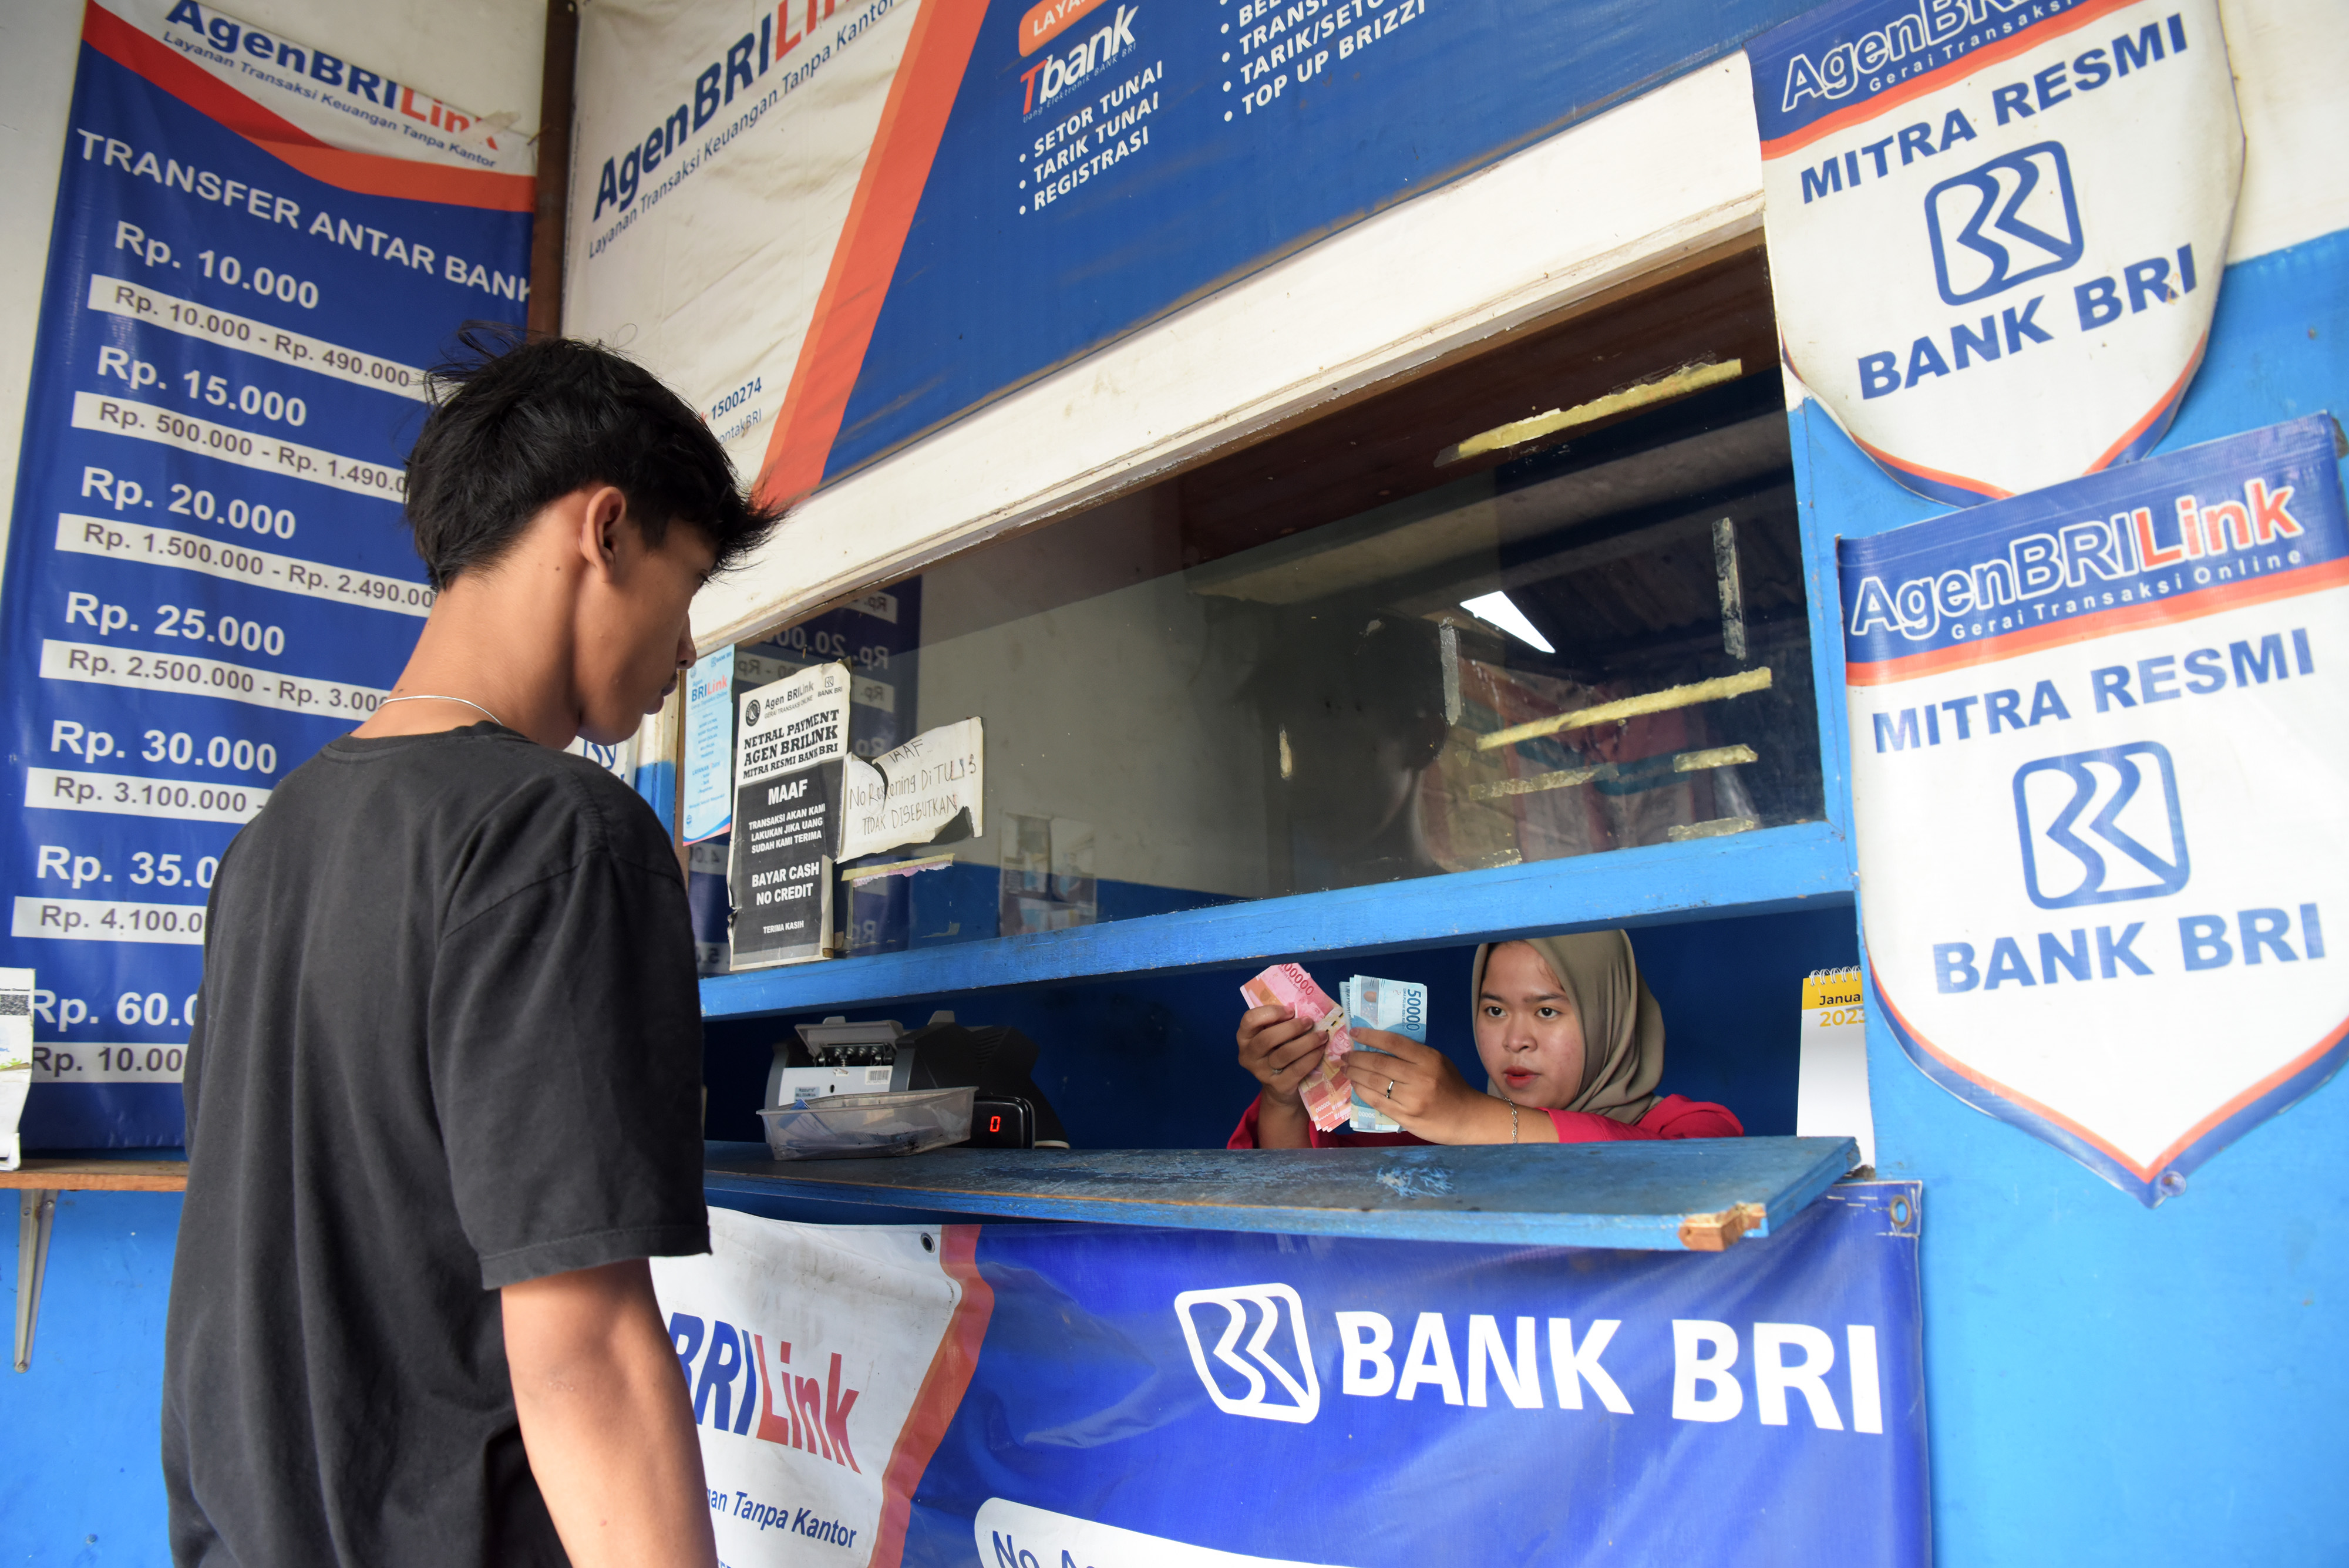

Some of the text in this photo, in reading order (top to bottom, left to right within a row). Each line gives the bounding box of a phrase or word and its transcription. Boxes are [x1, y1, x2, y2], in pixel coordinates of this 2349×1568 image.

[1020, 4, 1139, 116] Tbank
[1023, 42, 1136, 123] Uang Elektronik BANK BRI
[1242, 0, 1425, 115] TOP UP BRIZZI
[1869, 53, 1933, 93] Gerai
[163, 31, 497, 169] Layanan Transaksi Keuangan Tanpa Kantor
[1034, 60, 1162, 159] SETOR TUNAI
[1801, 13, 2188, 204] MITRA RESMI
[589, 207, 637, 260] Layanan
[640, 148, 700, 214] Transaksi
[704, 89, 778, 162] Keuangan
[782, 45, 830, 95] Tanpa
[1034, 91, 1159, 185] TARIK TUNAI
[1034, 126, 1150, 212] REGISTRASI
[77, 128, 301, 230] TRANSFER
[309, 211, 436, 275] ANTAR
[114, 220, 319, 309] Rp. 10.000
[114, 285, 159, 318] Rp.
[169, 303, 251, 343] 10.000
[274, 333, 315, 362] Rp.
[321, 350, 410, 388] 490.000
[1857, 243, 2198, 401] BANK BRI
[97, 345, 307, 426] Rp. 15.000
[711, 376, 762, 420] 1500274
[99, 401, 145, 429] Rp.
[156, 414, 253, 457] 500.000
[278, 446, 318, 473] Rp.
[81, 466, 296, 540] Rp. 20.000
[83, 523, 131, 550] Rp.
[142, 533, 264, 575] 1.500.000
[288, 564, 328, 591] Rp.
[1850, 477, 2304, 641] AgenBRILink
[65, 591, 285, 656] Rp. 25.000
[1951, 550, 2301, 640] Gerai Transaksi Online
[68, 649, 116, 677] Rp.
[127, 655, 254, 692] 2.500.000
[278, 680, 320, 706] Rp.
[329, 688, 388, 712] 3.00
[692, 674, 728, 702] BRILink
[765, 681, 814, 710] Agen BRILink
[817, 689, 834, 698] BANK
[1872, 627, 2315, 754] MITRA RESMI
[743, 727, 785, 750] NETRAL
[786, 709, 839, 736] PAYMENT
[764, 710, 778, 719] GERAI
[778, 702, 800, 715] TRANSAKSI
[51, 719, 278, 775] Rp. 30.000
[743, 743, 778, 766] AGEN
[780, 725, 838, 755] BRILINK
[743, 764, 769, 779] MITRA
[770, 756, 796, 771] RESMI
[798, 748, 818, 763] BANK
[819, 743, 838, 755] BRI
[54, 776, 248, 812] Rp. 3.100.000
[748, 803, 826, 830] TRANSAKSI AKAN KAMI
[768, 779, 808, 805] MAAF
[849, 785, 866, 810] No
[862, 793, 958, 836] TIDAK DISEBUTKAN
[751, 817, 823, 842] LAKUKAN JIKA UANG
[751, 830, 822, 854] SUDAH KAMI TERIMA
[36, 844, 113, 889] Rp.
[752, 862, 820, 887] BAYAR CASH
[756, 883, 813, 906] NO CREDIT
[41, 904, 203, 933] Rp. 4.100.0
[763, 920, 805, 934] TERIMA KASIH
[1931, 903, 2326, 995] BANK BRI
[1405, 988, 1421, 1031] 50000
[1819, 993, 1863, 1006] Janua
[990, 1115, 1001, 1133] 0
[1335, 1311, 1883, 1434] BANK BRI
[733, 1490, 789, 1531] Tanpa
[791, 1507, 857, 1549] Kantor
